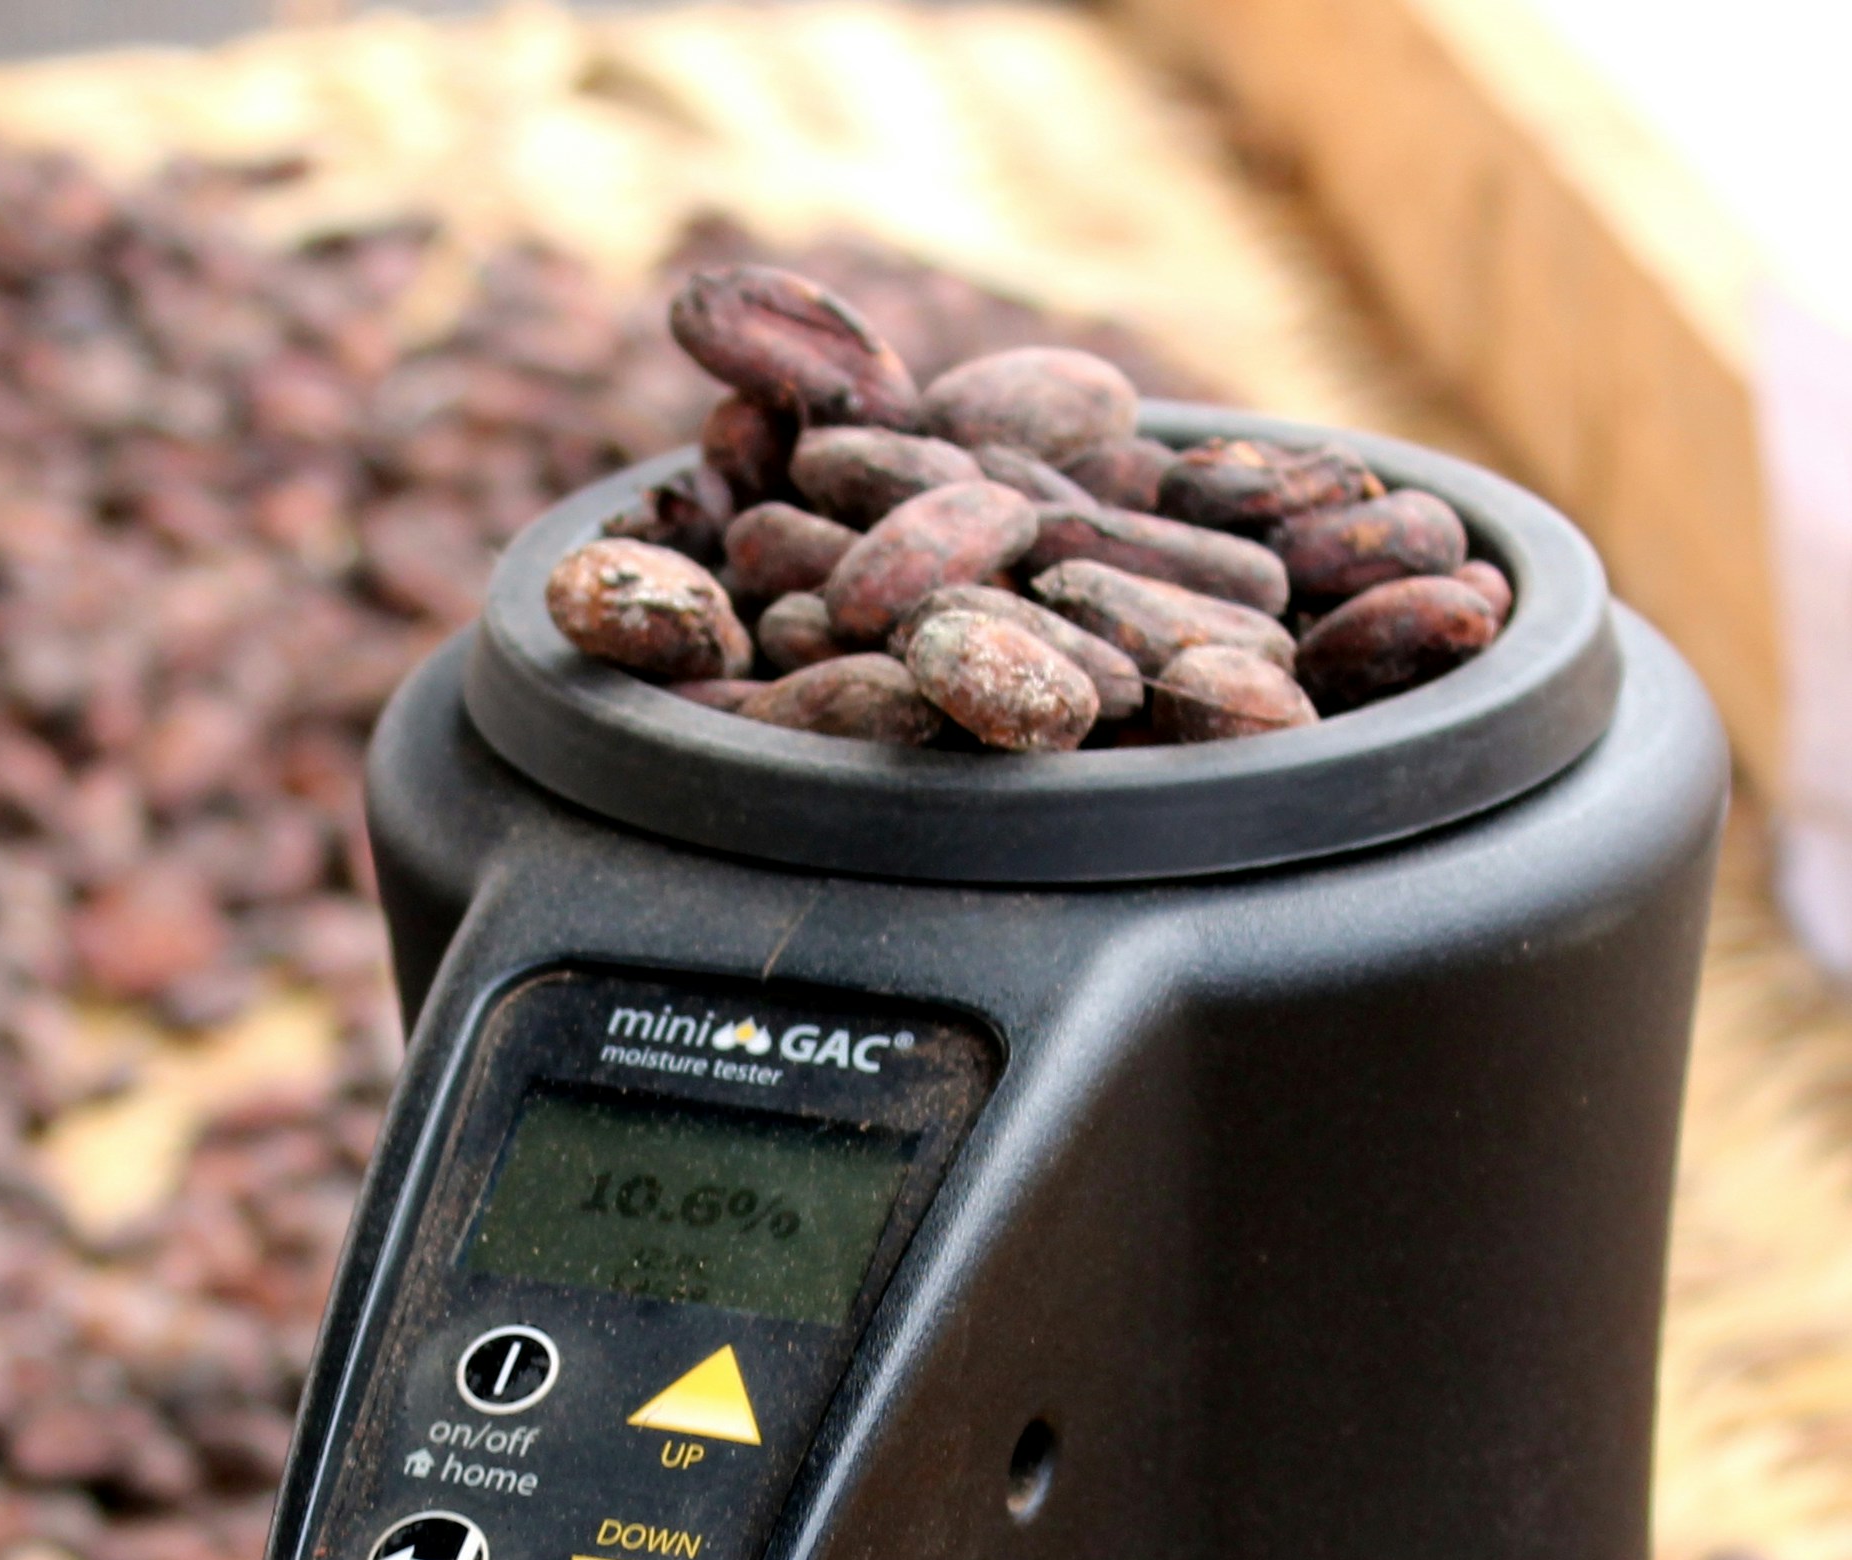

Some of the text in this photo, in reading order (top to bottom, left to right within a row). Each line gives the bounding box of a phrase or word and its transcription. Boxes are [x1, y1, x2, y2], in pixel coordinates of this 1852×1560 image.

[608, 1004, 715, 1048] mini
[600, 1044, 784, 1086] moisture tester
[580, 1171, 802, 1241] 10.6%
[428, 1420, 541, 1458] on/off
[660, 1441, 706, 1471] UP
[441, 1453, 539, 1497] home
[596, 1518, 703, 1560] DOWN
